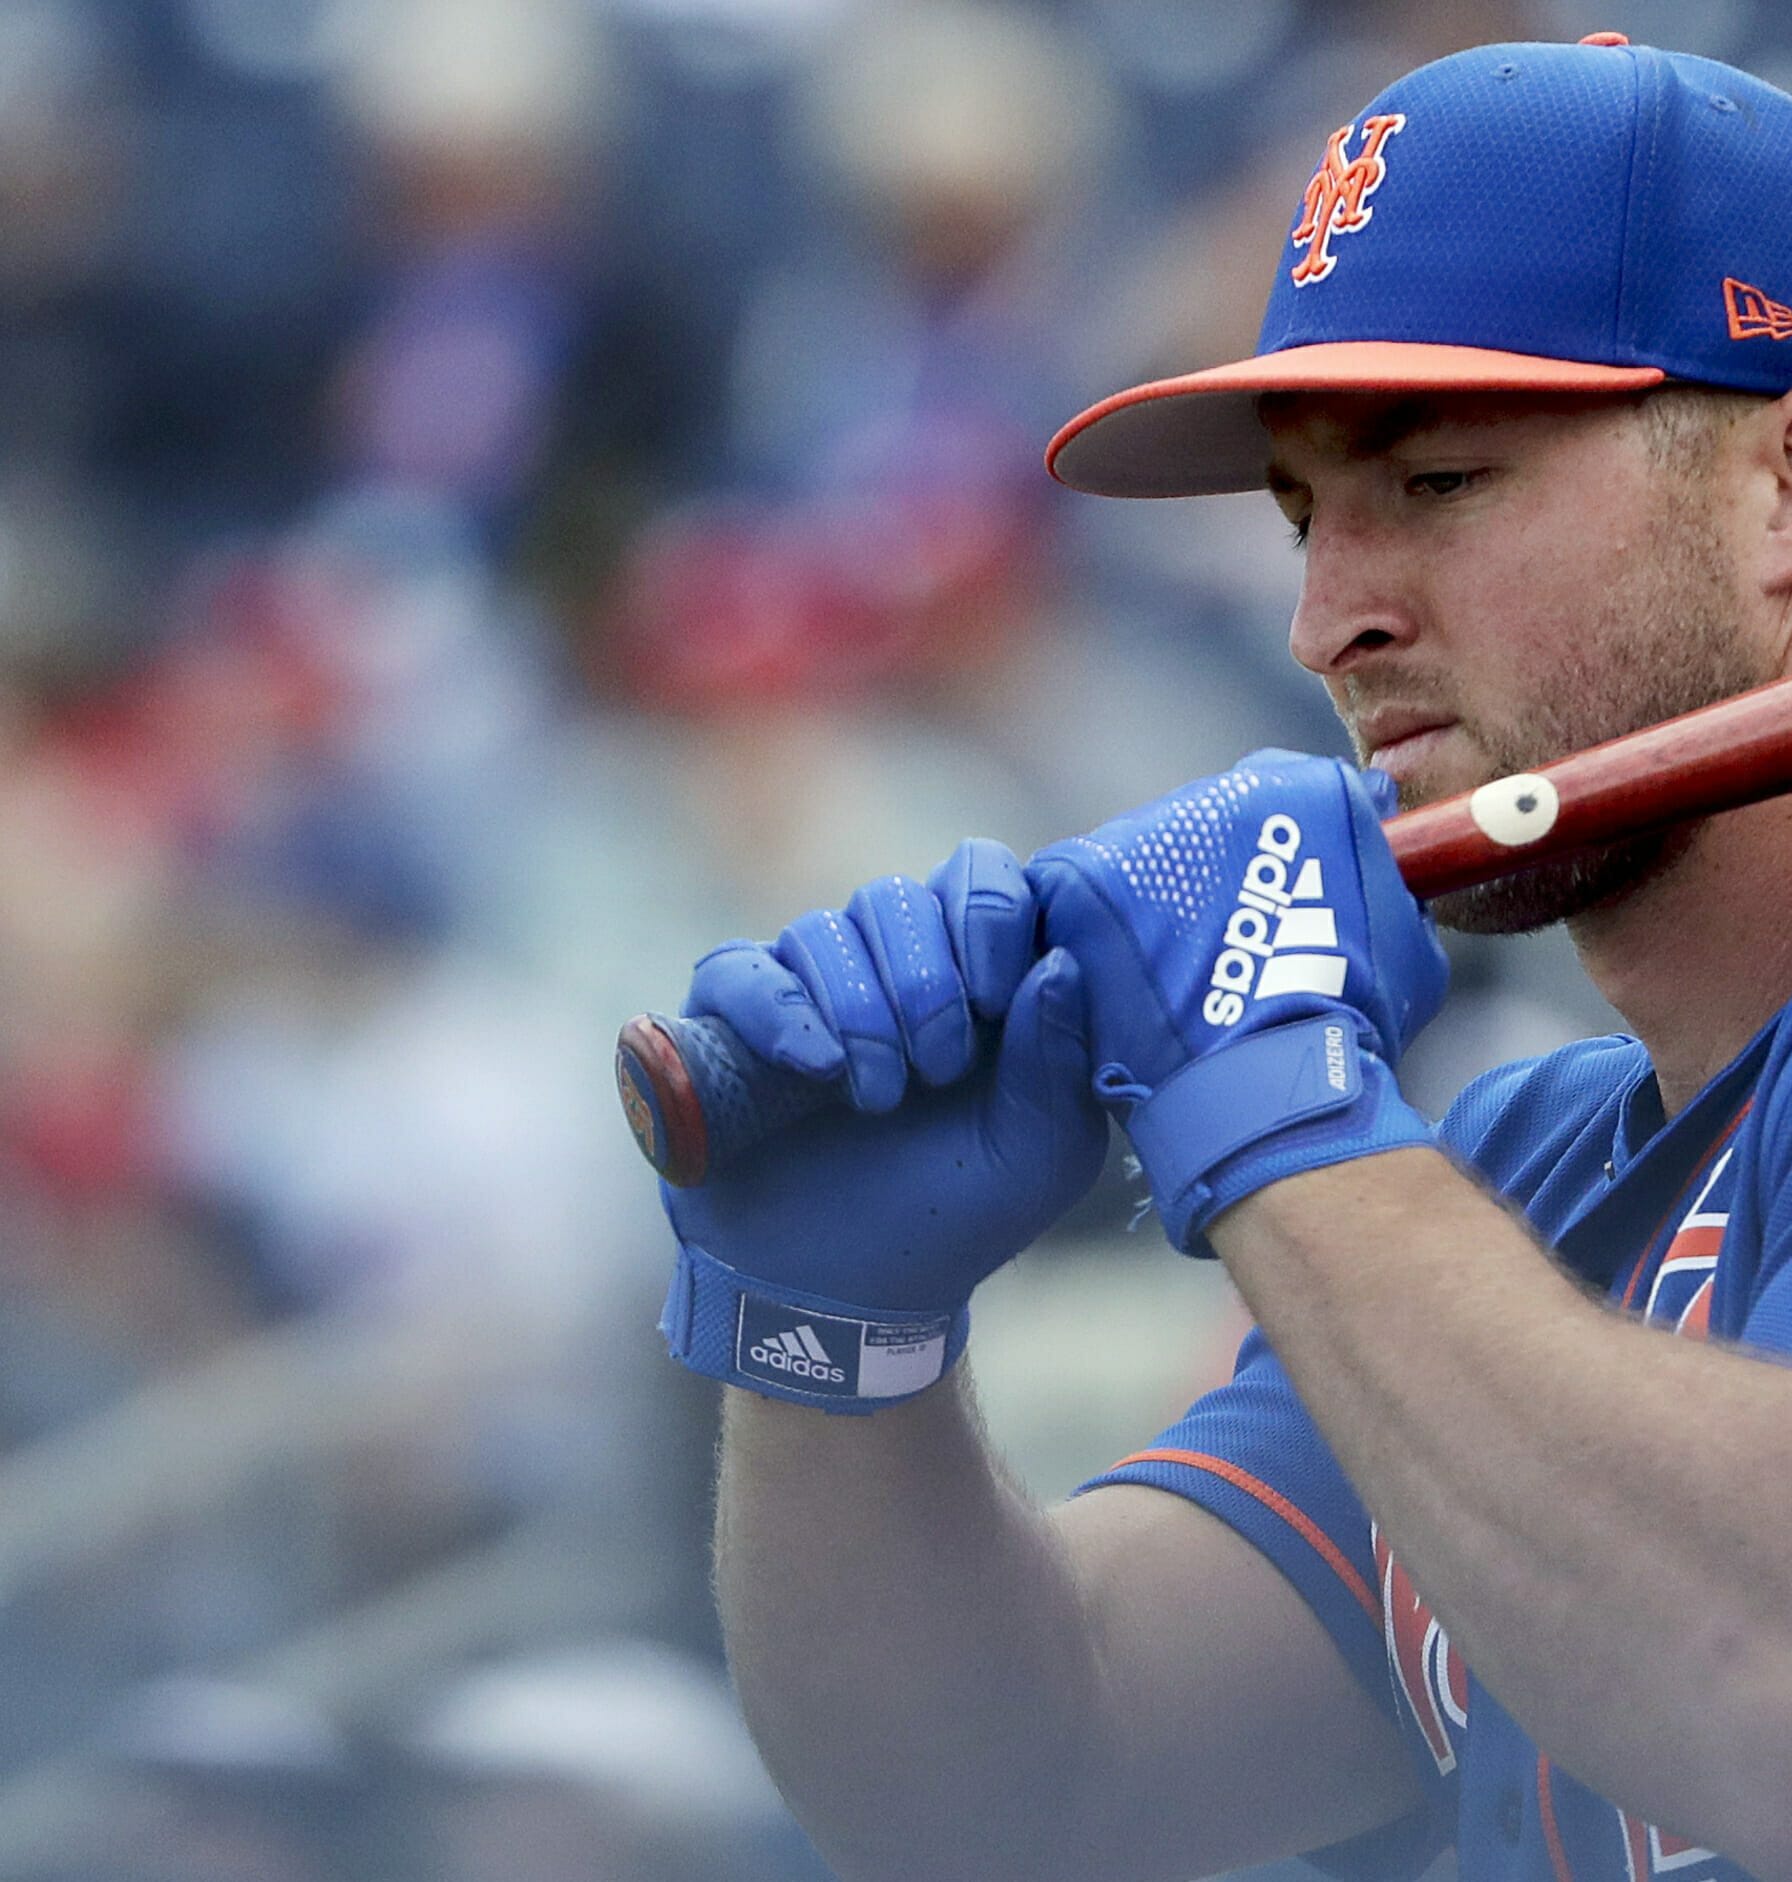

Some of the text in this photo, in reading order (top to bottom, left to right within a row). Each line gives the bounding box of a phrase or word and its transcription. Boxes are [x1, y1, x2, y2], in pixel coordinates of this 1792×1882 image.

[1203, 813, 1301, 1027] adidas
[1325, 1026, 1346, 1092] ADIZERO
[750, 1346, 845, 1383] adidas
